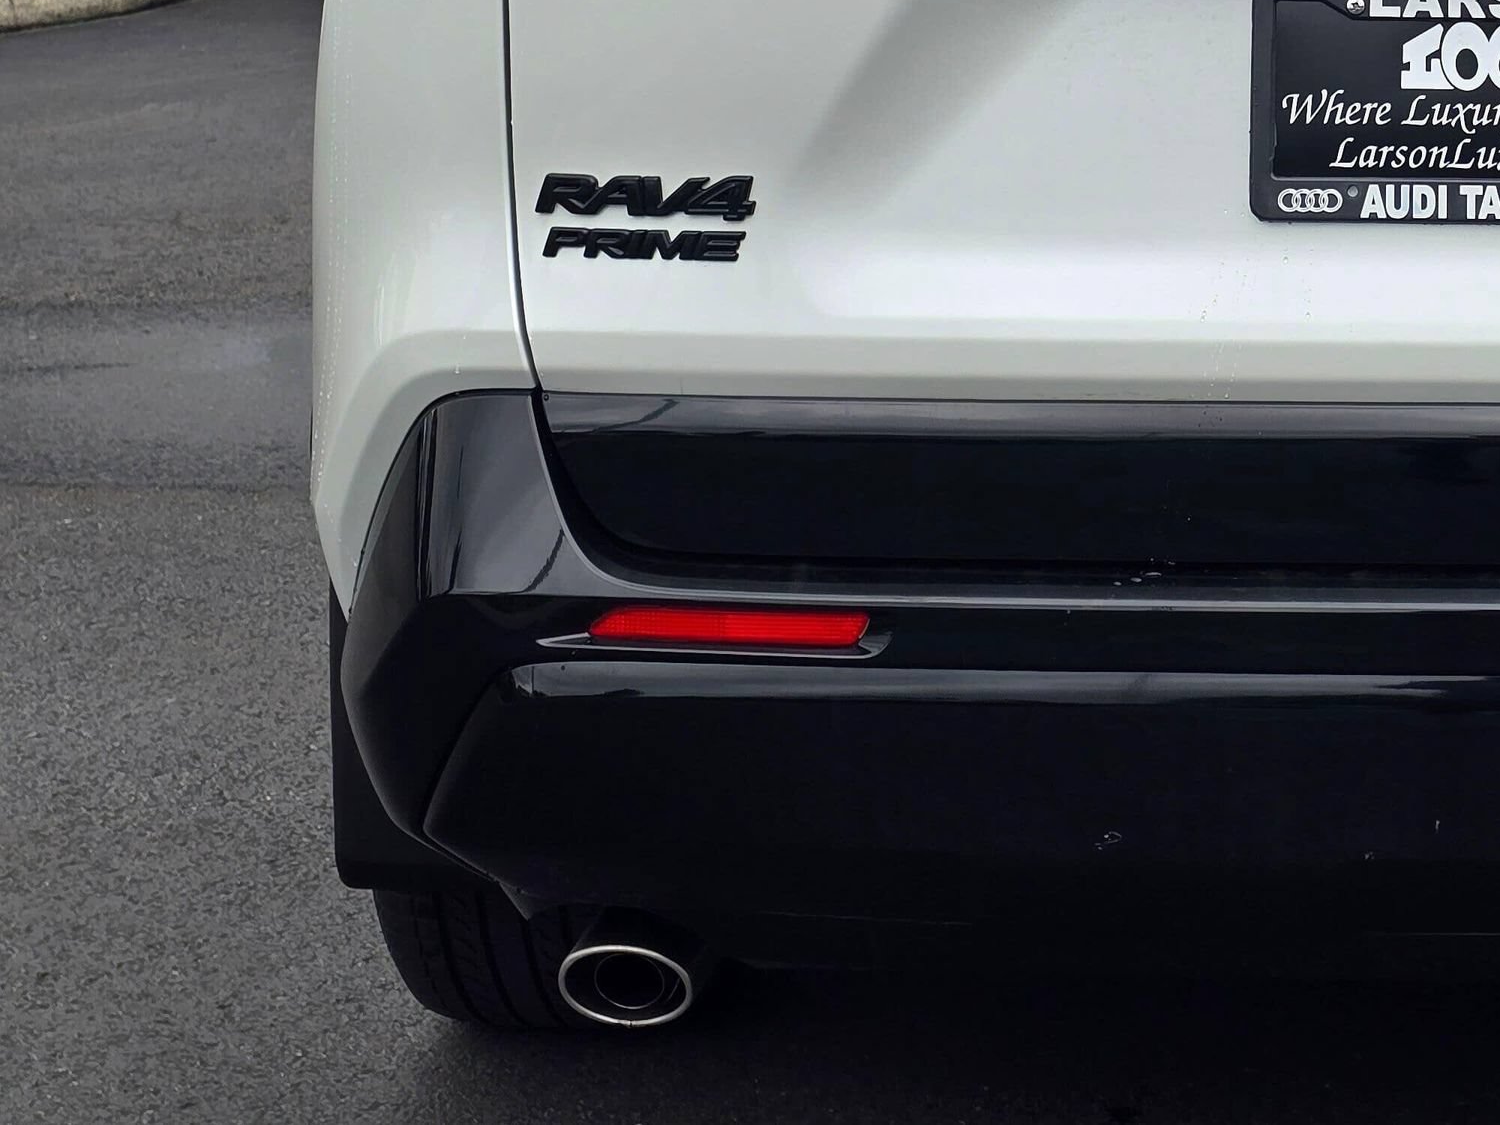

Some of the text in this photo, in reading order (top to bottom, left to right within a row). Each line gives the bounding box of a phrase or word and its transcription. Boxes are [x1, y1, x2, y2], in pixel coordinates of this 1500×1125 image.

[1281, 89, 1393, 128] Where
[535, 173, 757, 221] RAV4
[1360, 184, 1449, 220] AUDI
[542, 226, 746, 262] PRIME
